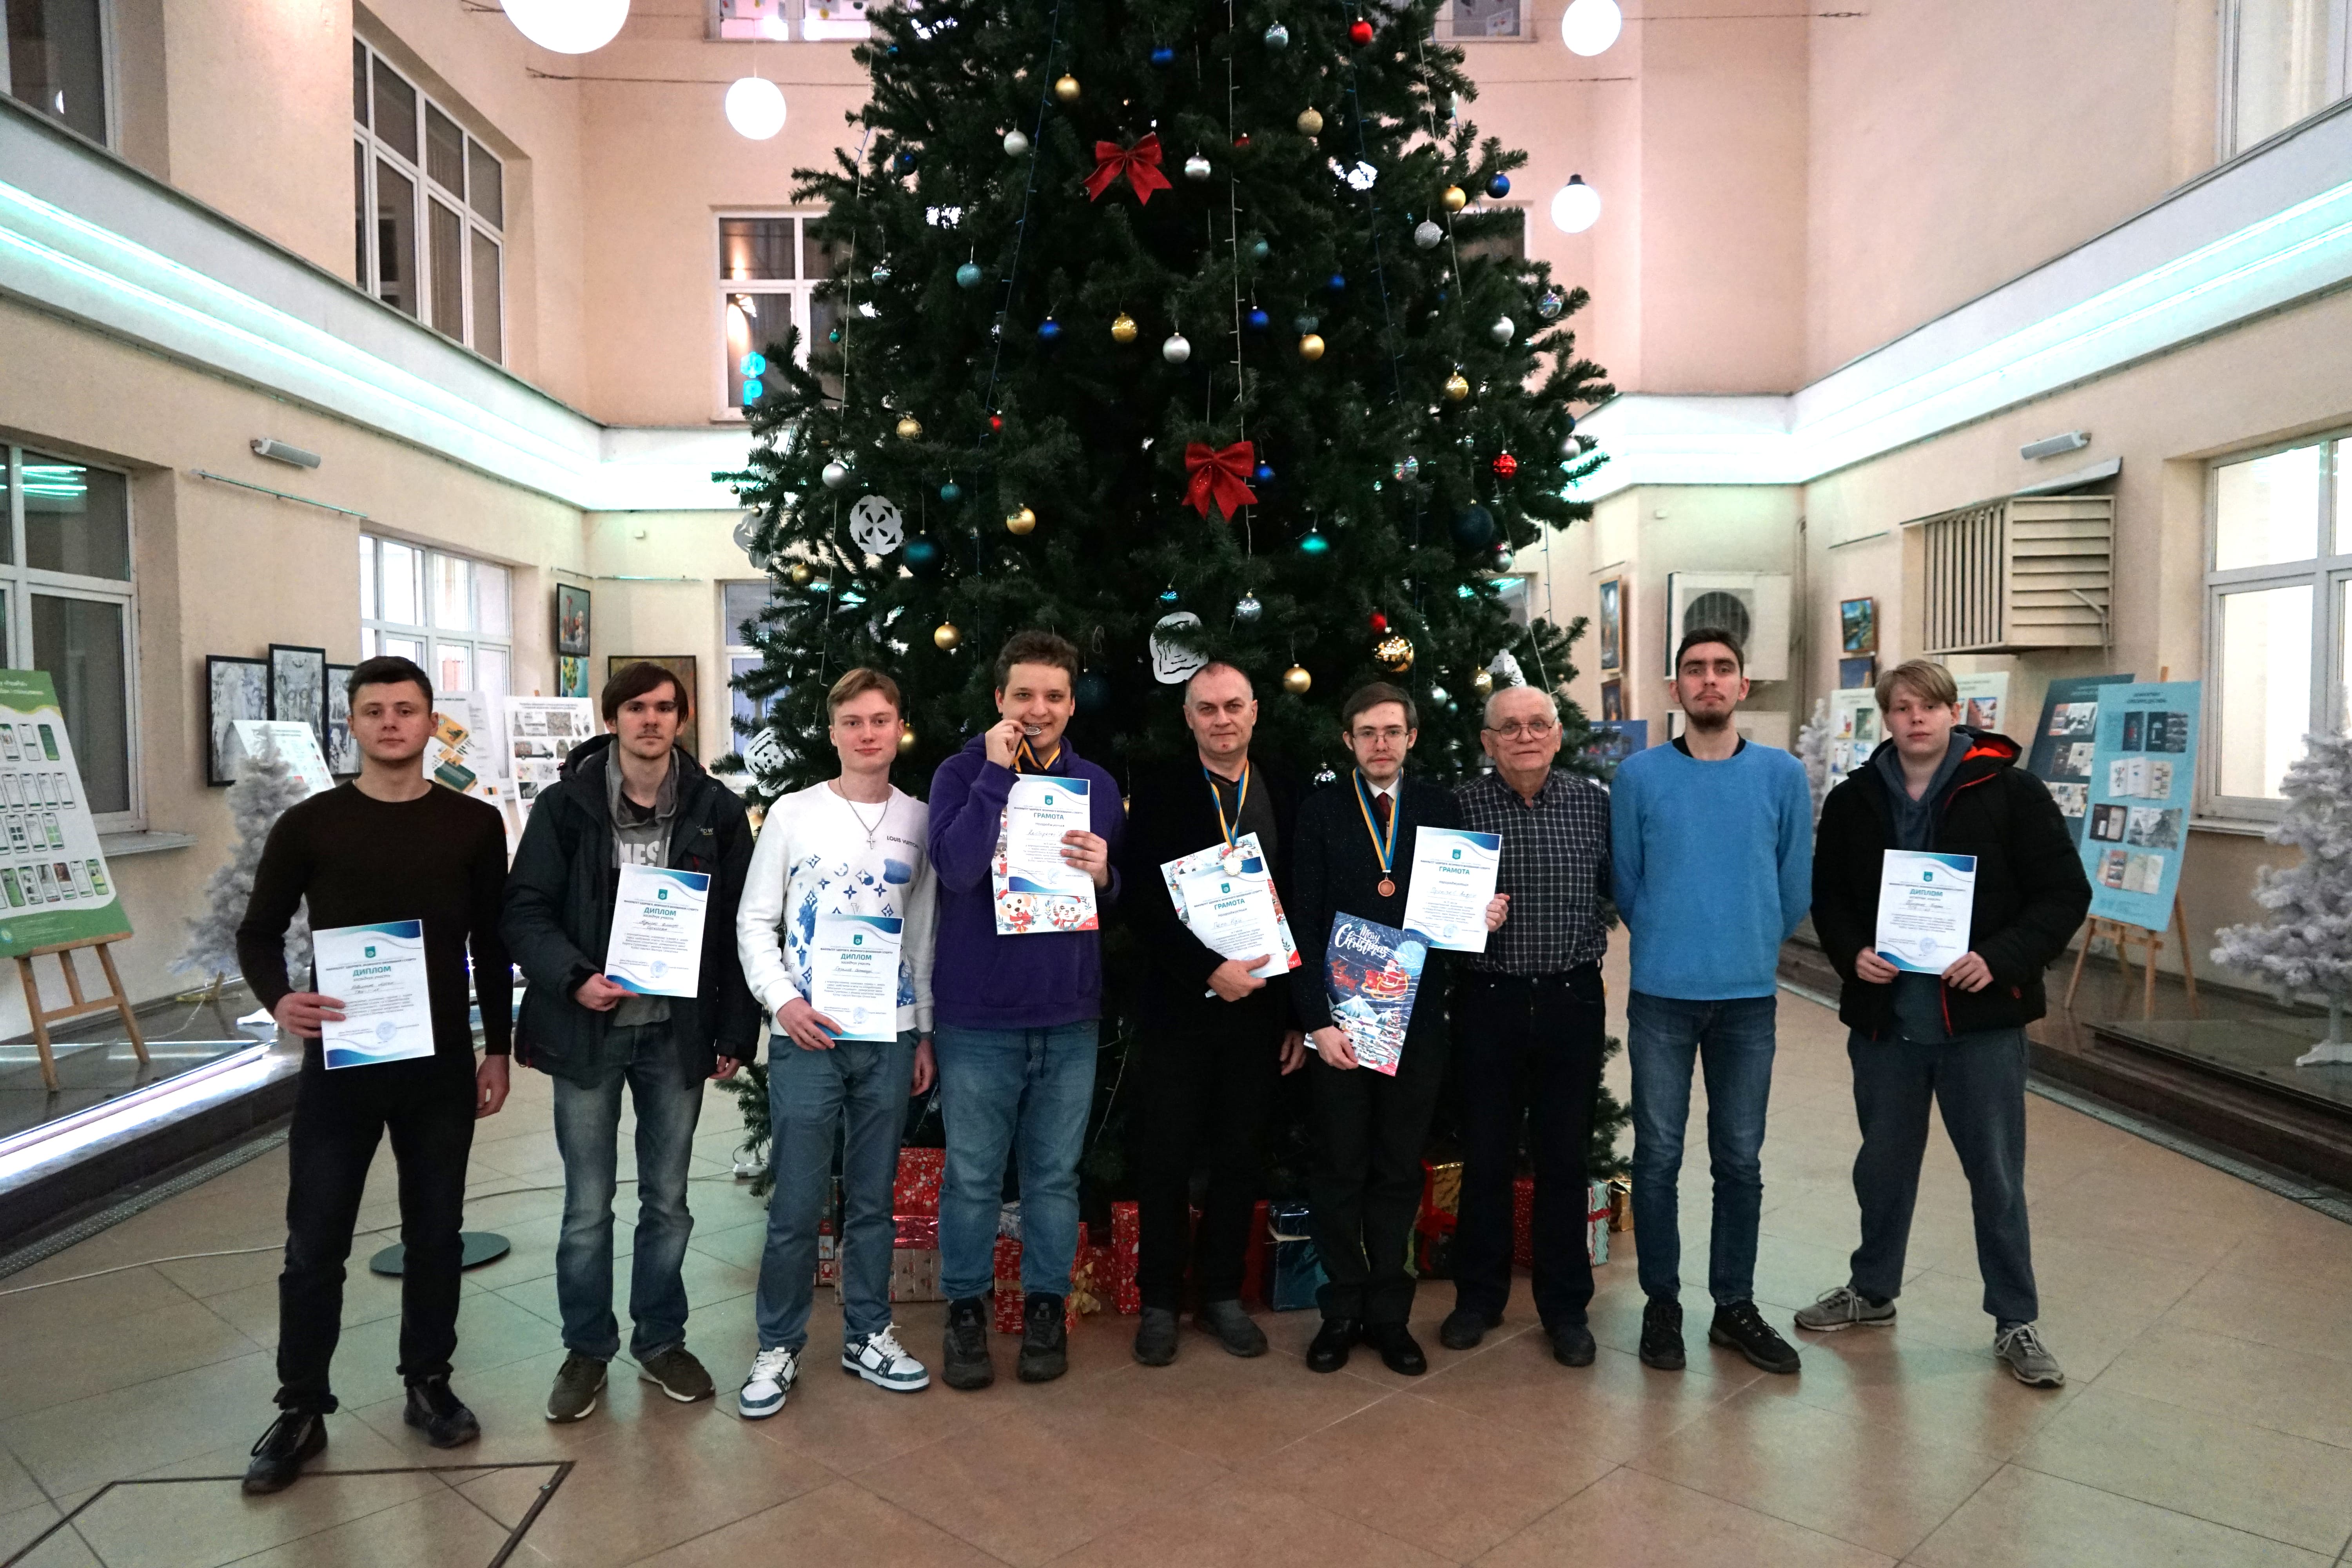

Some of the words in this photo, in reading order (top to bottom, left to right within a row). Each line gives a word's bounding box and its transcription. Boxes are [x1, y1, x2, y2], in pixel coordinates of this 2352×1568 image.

[902, 839, 919, 849] VUITTON
[1439, 866, 1470, 875] ГРАМОТА
[1910, 889, 1943, 897] ДИПЛОМ
[1214, 898, 1245, 910] ГРАМОТА
[644, 907, 676, 916] ДИПЛОМ
[1334, 923, 1388, 957] Christmas
[353, 966, 391, 977] ДИПЛОМ
